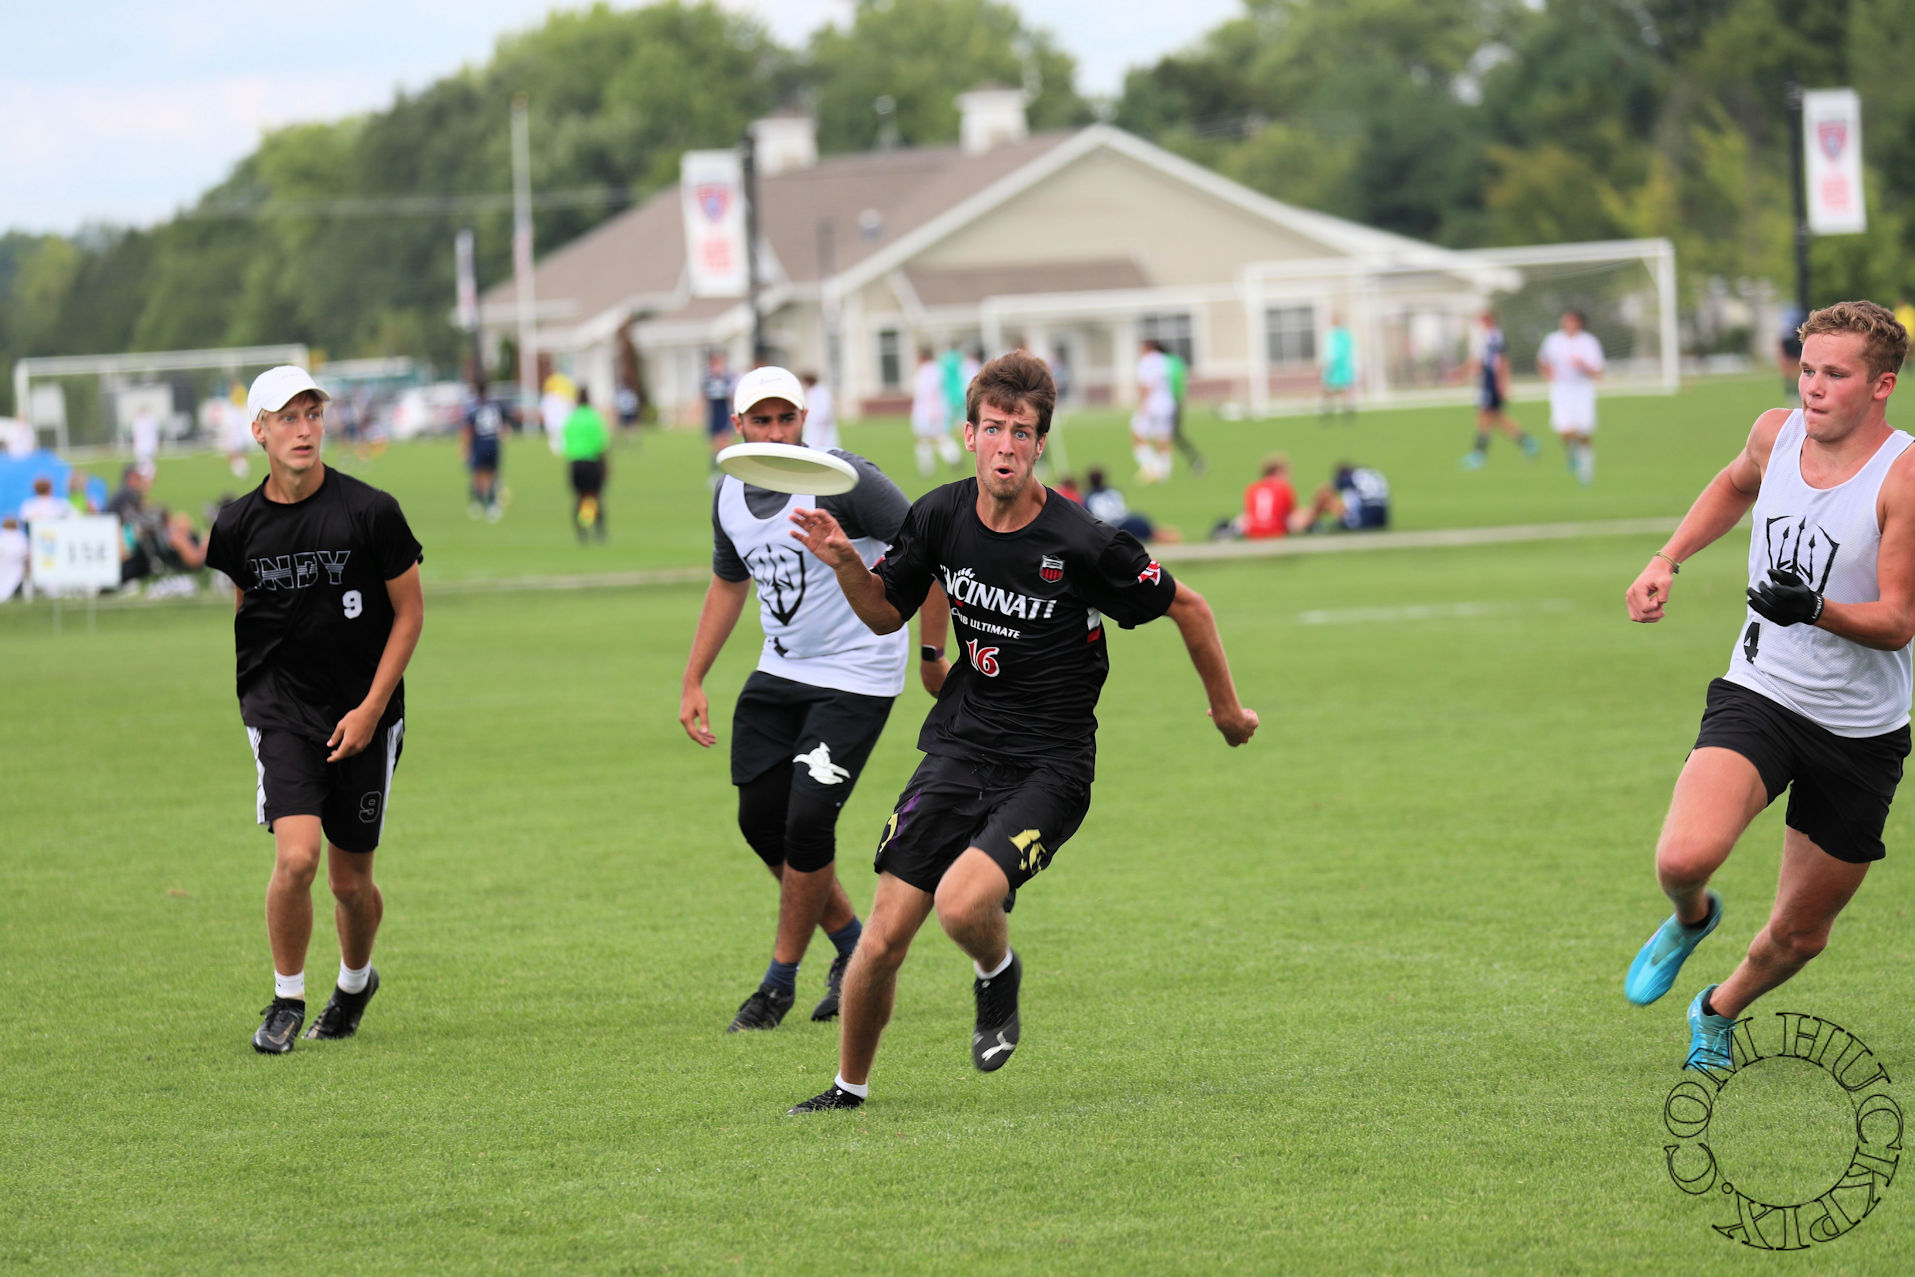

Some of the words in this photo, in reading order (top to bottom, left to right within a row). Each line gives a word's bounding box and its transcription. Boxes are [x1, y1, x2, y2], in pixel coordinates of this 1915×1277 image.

[342, 589, 363, 619] 9
[970, 618, 1021, 639] ULTIMATE
[965, 638, 1000, 677] 16
[358, 790, 382, 823] 9
